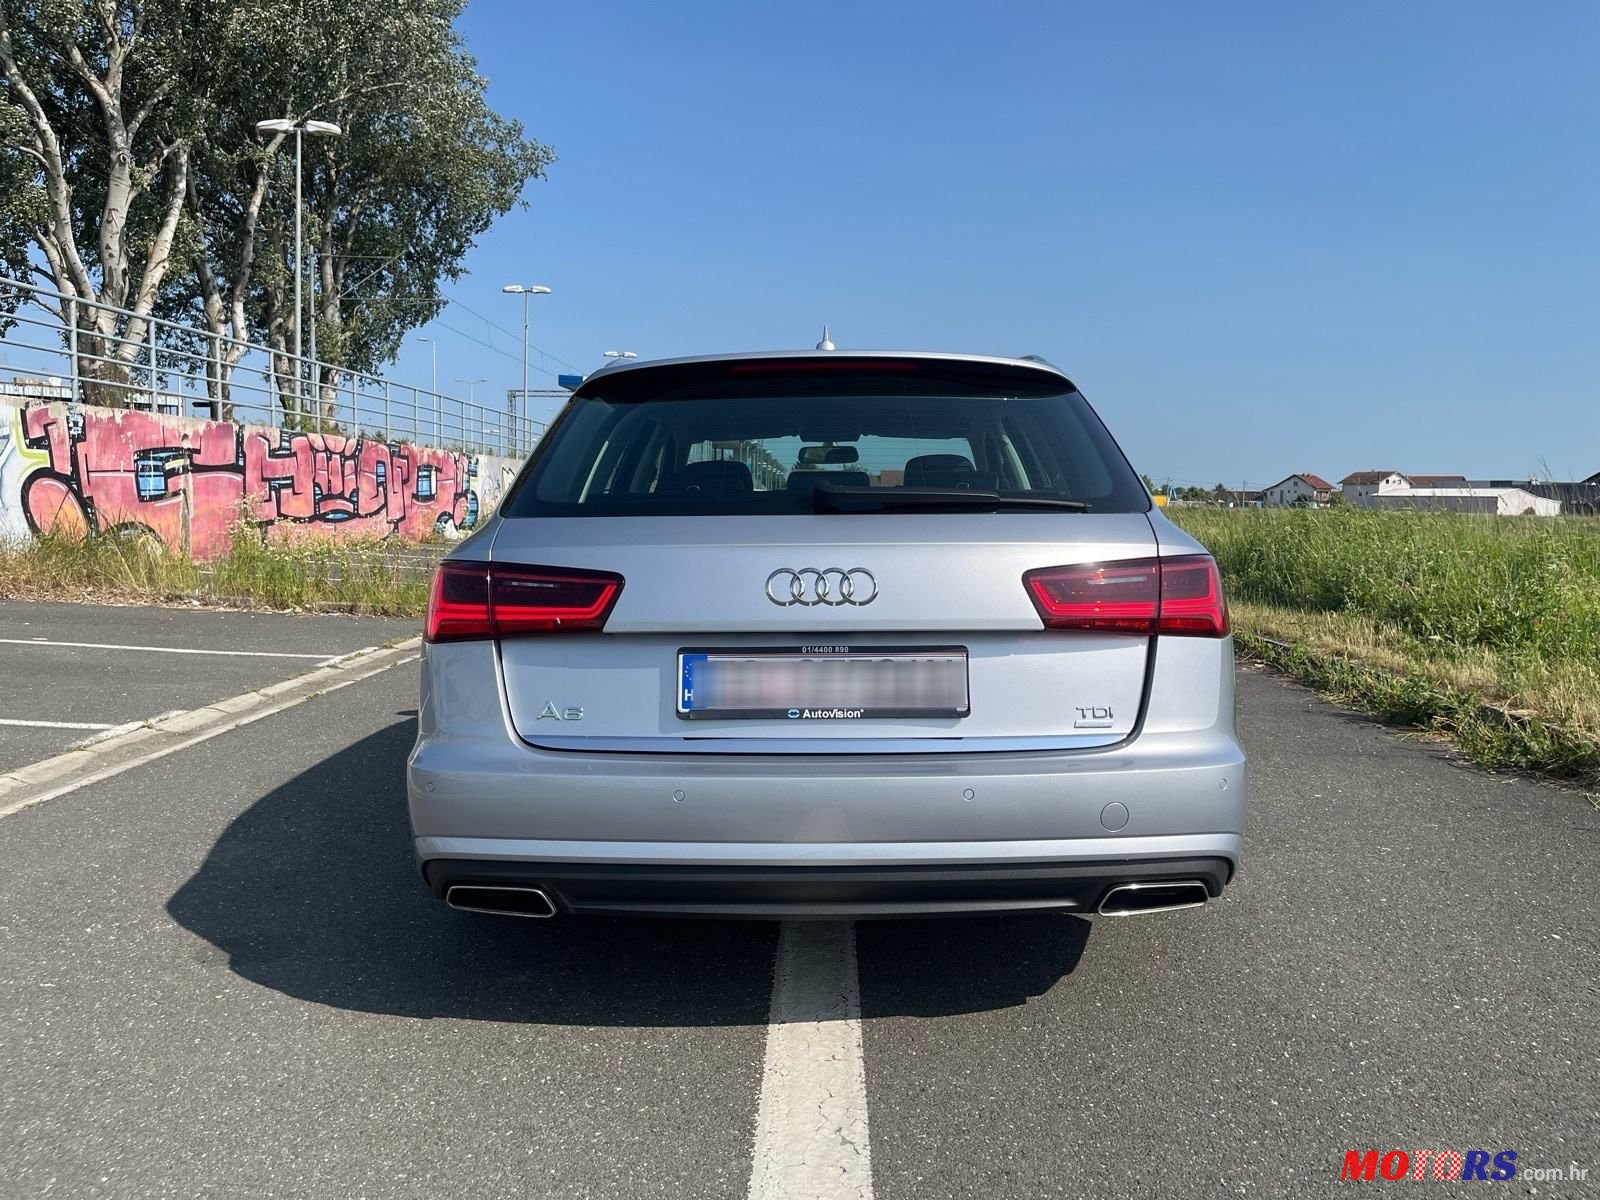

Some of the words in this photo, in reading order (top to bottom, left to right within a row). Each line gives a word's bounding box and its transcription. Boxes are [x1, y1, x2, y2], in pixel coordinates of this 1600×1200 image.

[537, 700, 584, 720] A6
[802, 708, 861, 718] AutoVision
[1075, 706, 1114, 719] TDI
